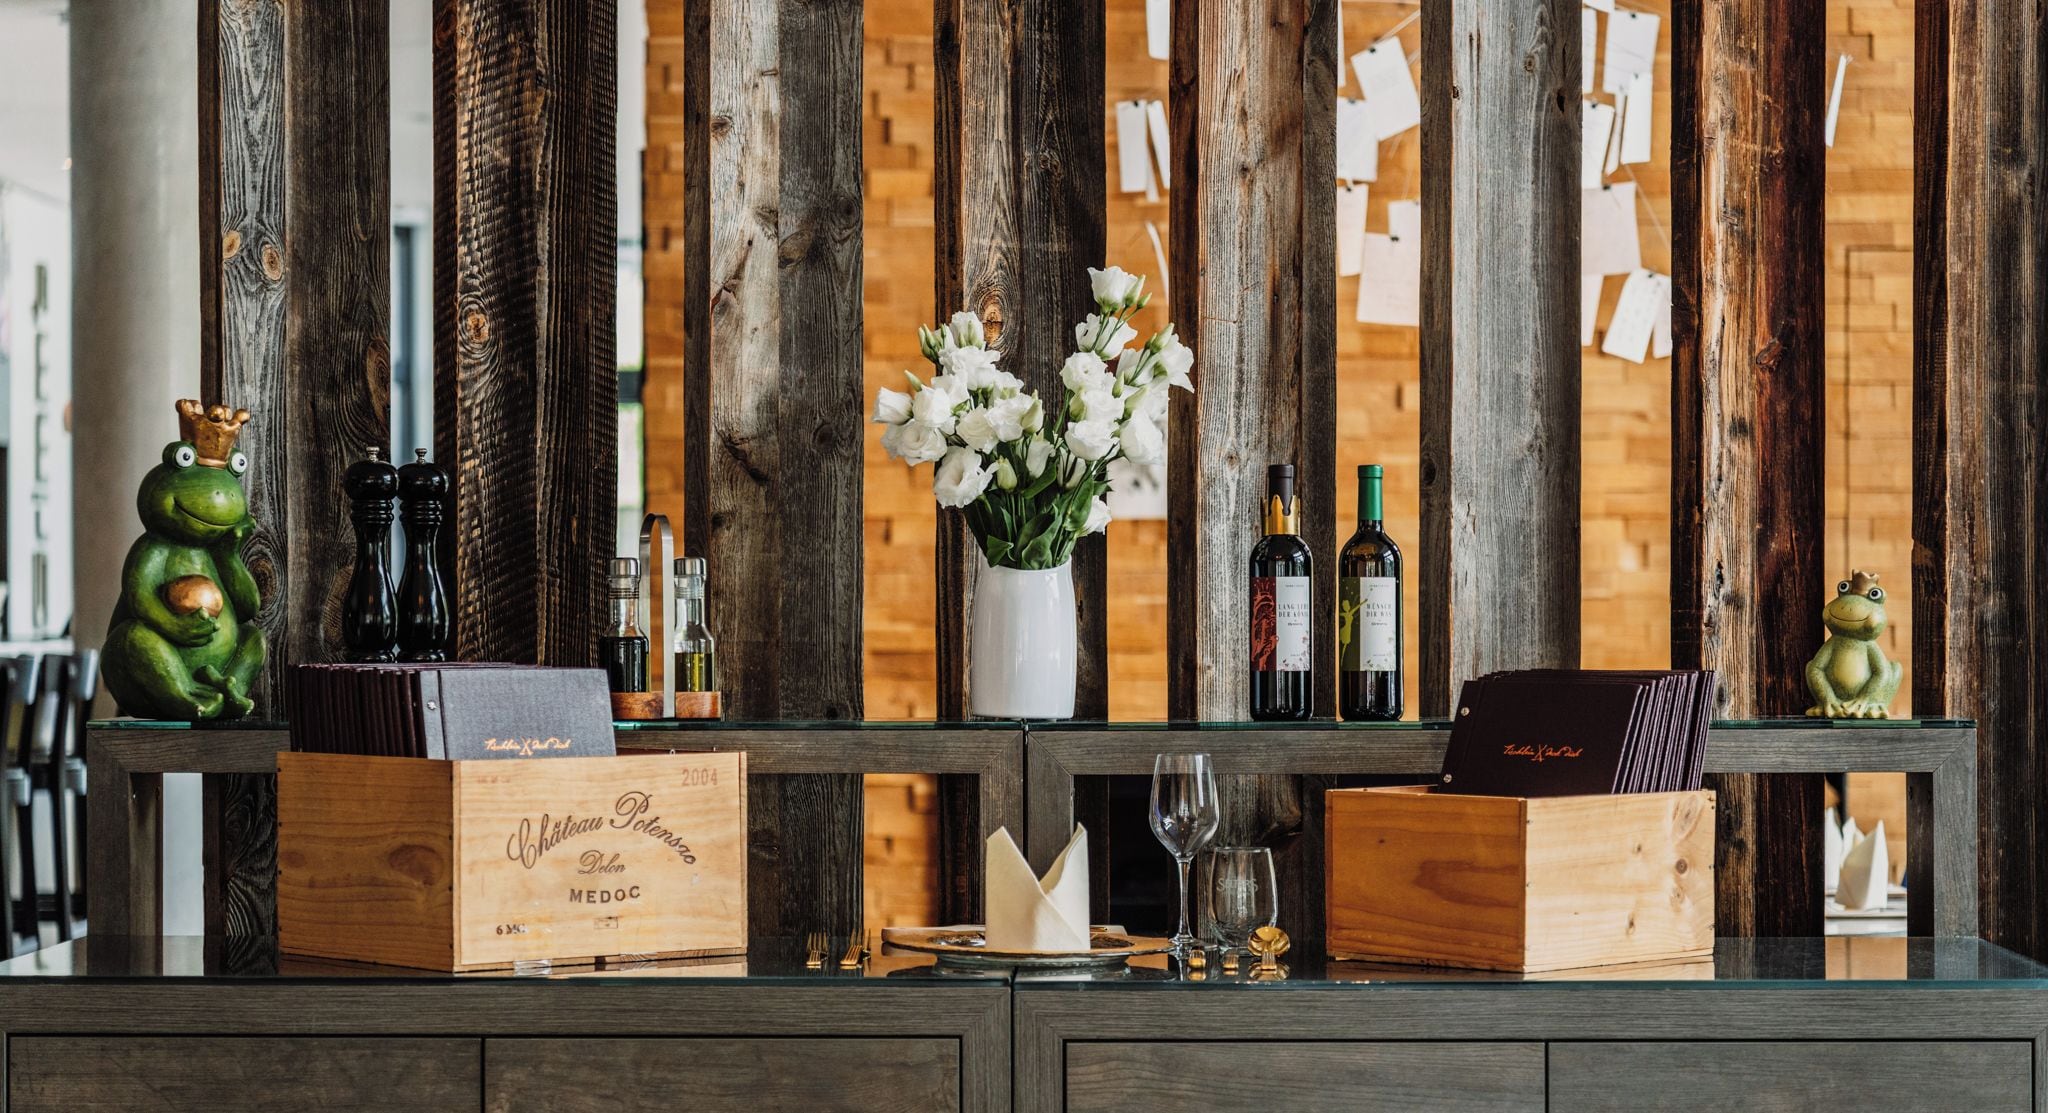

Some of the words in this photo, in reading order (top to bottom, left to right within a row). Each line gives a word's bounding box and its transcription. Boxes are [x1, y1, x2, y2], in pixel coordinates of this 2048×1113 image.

[681, 768, 718, 787] 2004
[577, 850, 626, 875] Delon
[569, 885, 641, 903] MEDOC
[496, 924, 503, 936] 6
